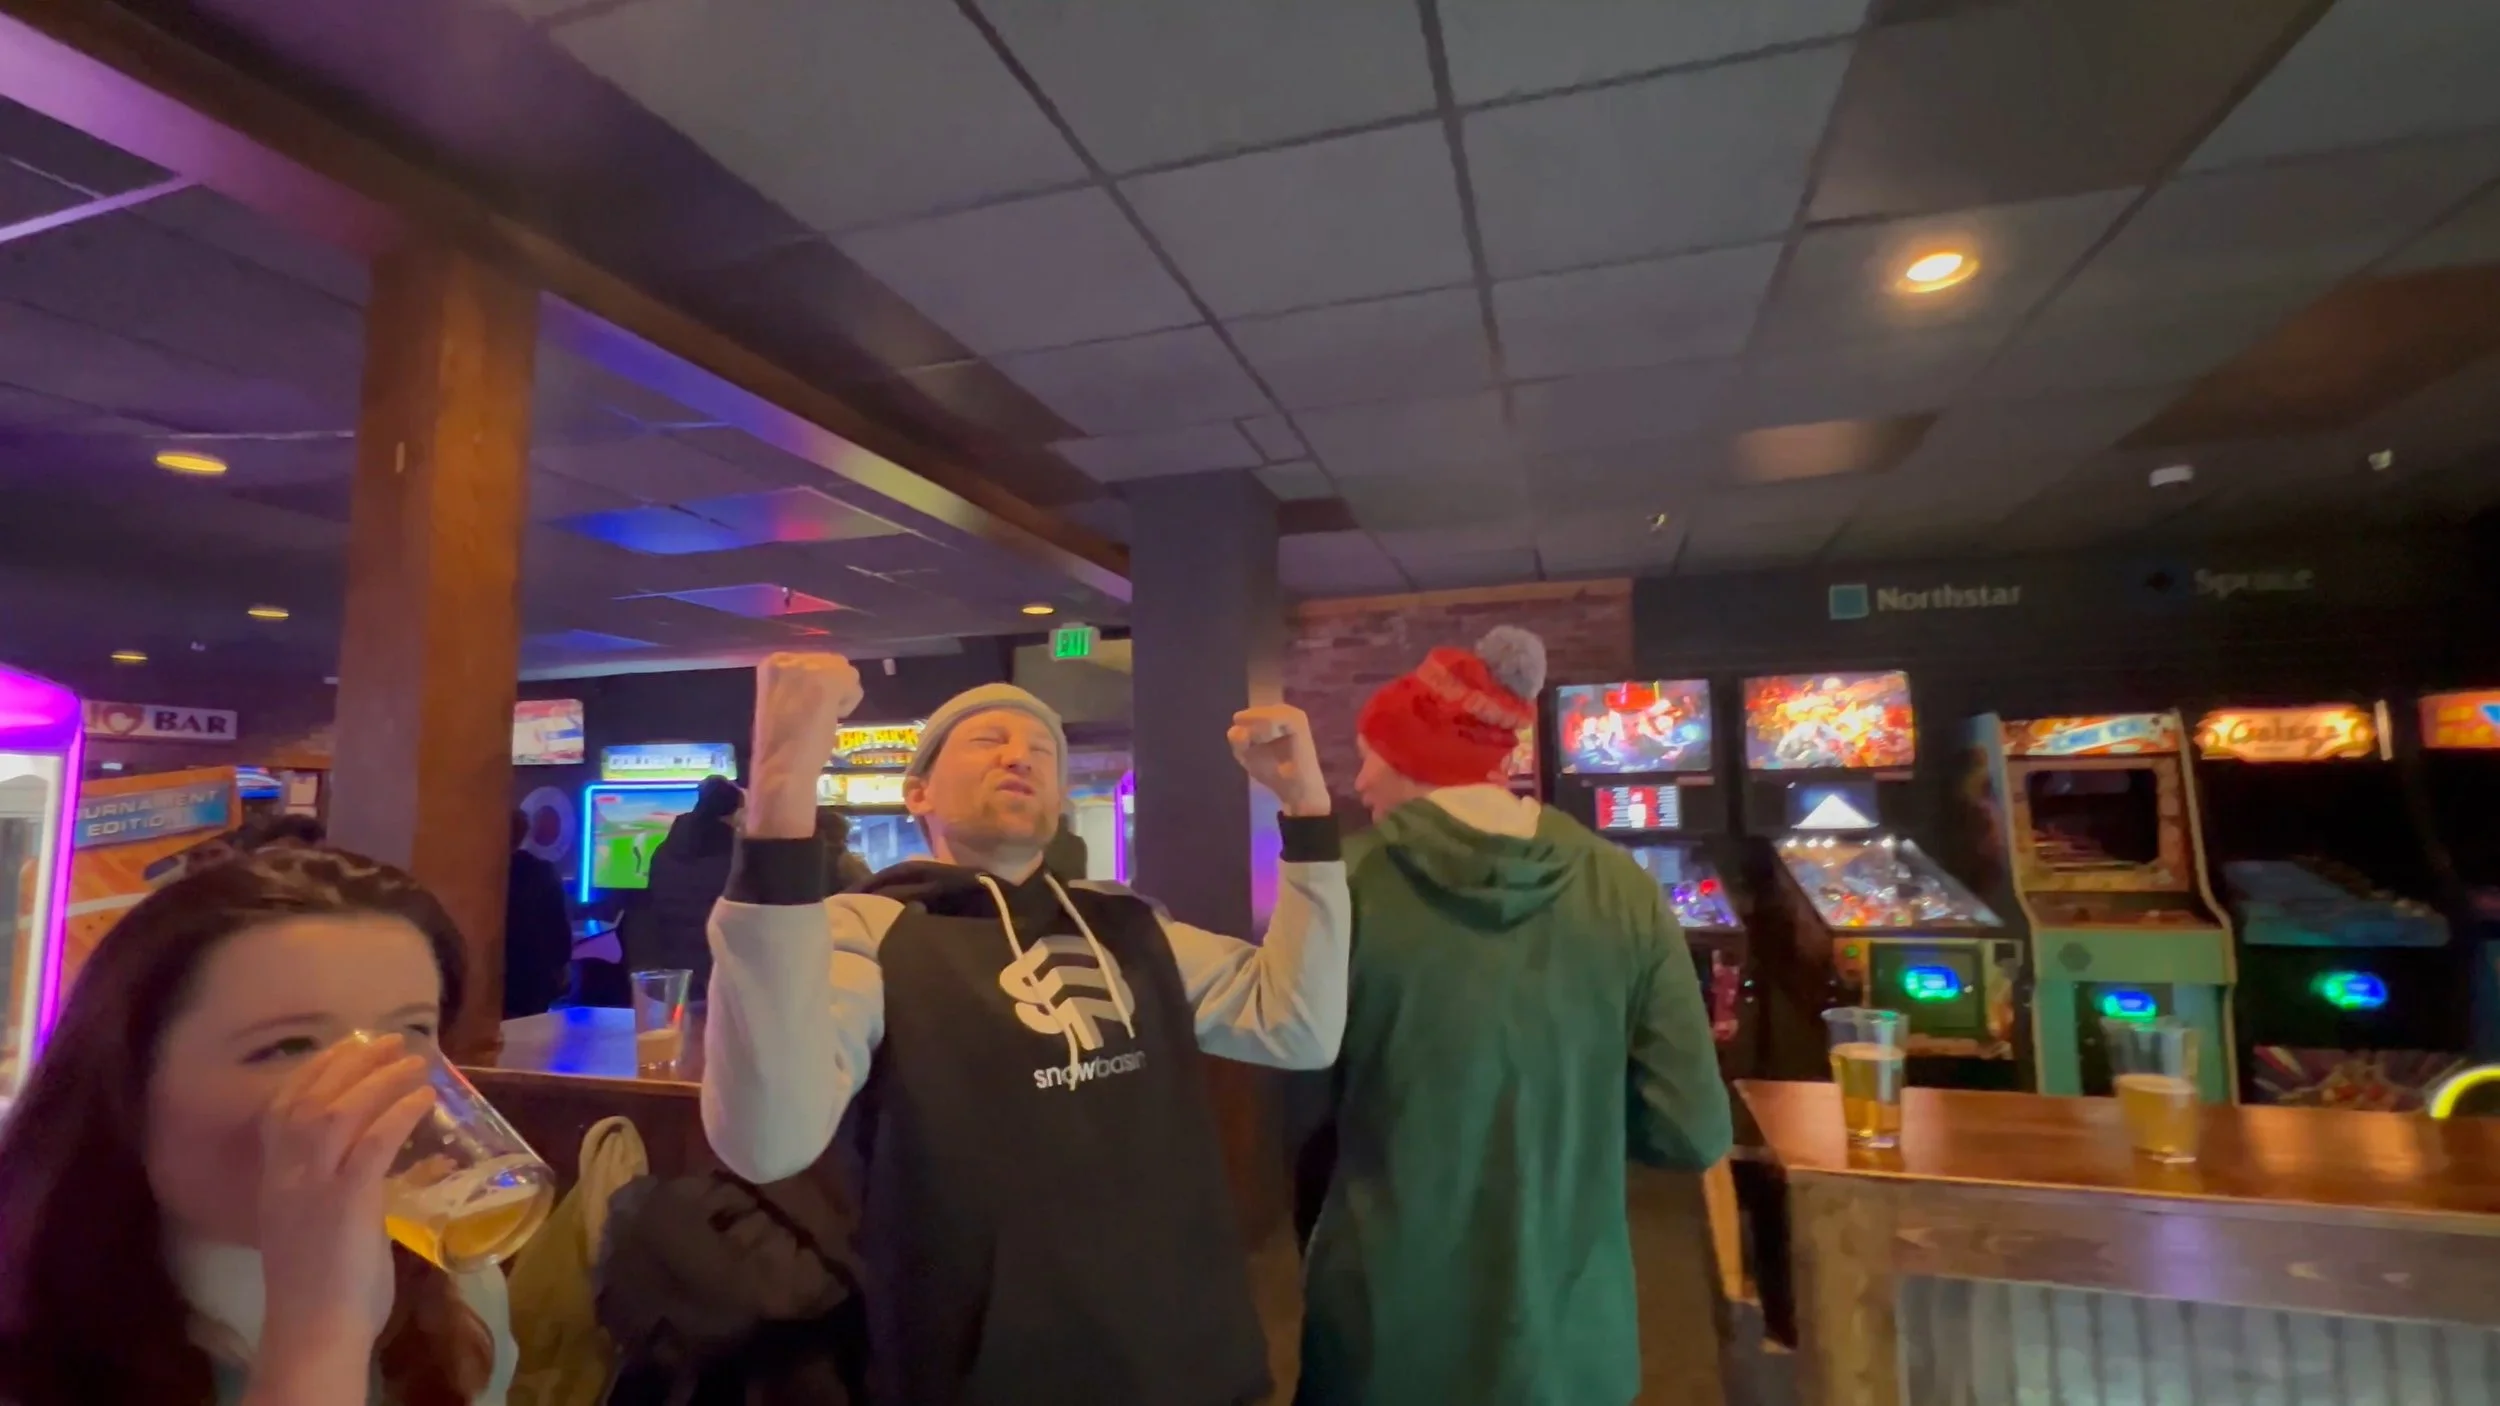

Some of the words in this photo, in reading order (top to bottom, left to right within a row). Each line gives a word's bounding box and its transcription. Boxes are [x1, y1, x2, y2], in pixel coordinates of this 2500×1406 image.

[1877, 583, 2022, 612] Northstar
[154, 711, 228, 734] BAR
[80, 791, 218, 820] URNAENT
